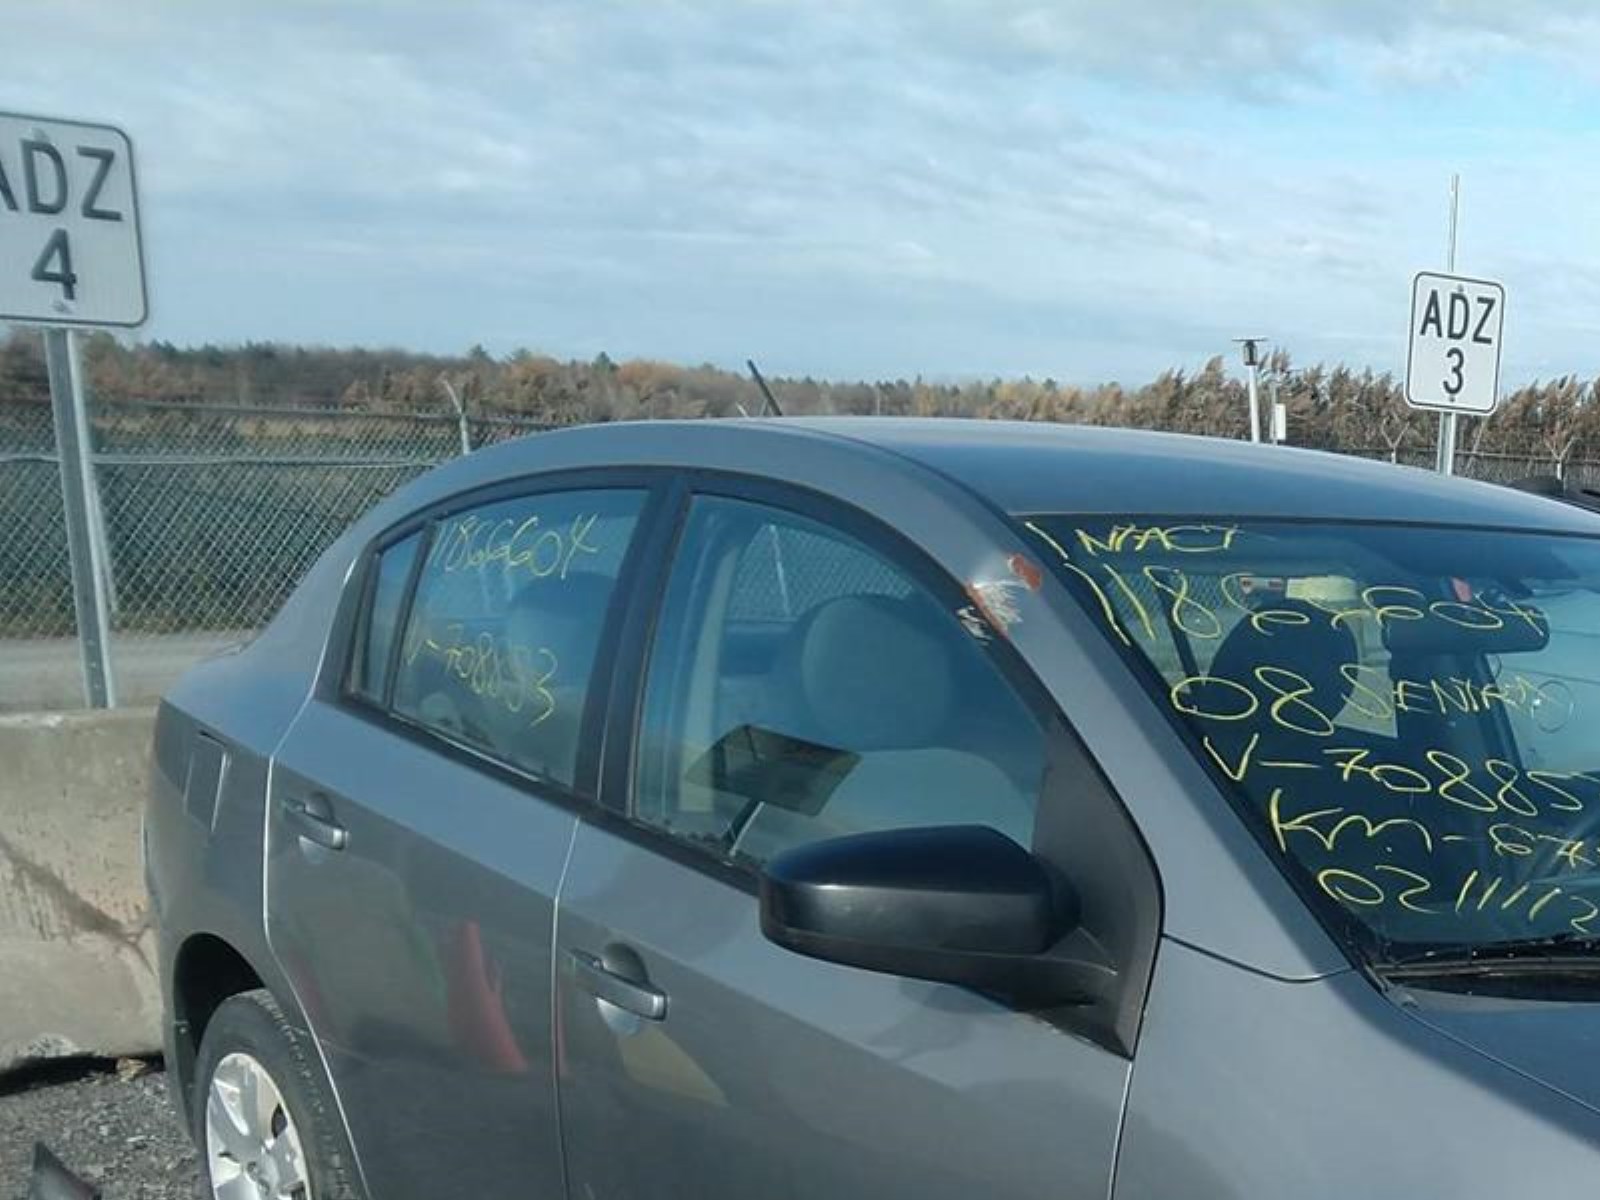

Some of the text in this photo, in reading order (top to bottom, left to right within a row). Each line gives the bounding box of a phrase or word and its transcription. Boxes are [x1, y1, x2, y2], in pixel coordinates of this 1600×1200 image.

[32, 227, 77, 301] 4
[1419, 289, 1496, 345] ADZ
[1443, 346, 1465, 395] 3
[1171, 666, 1335, 736] 08
